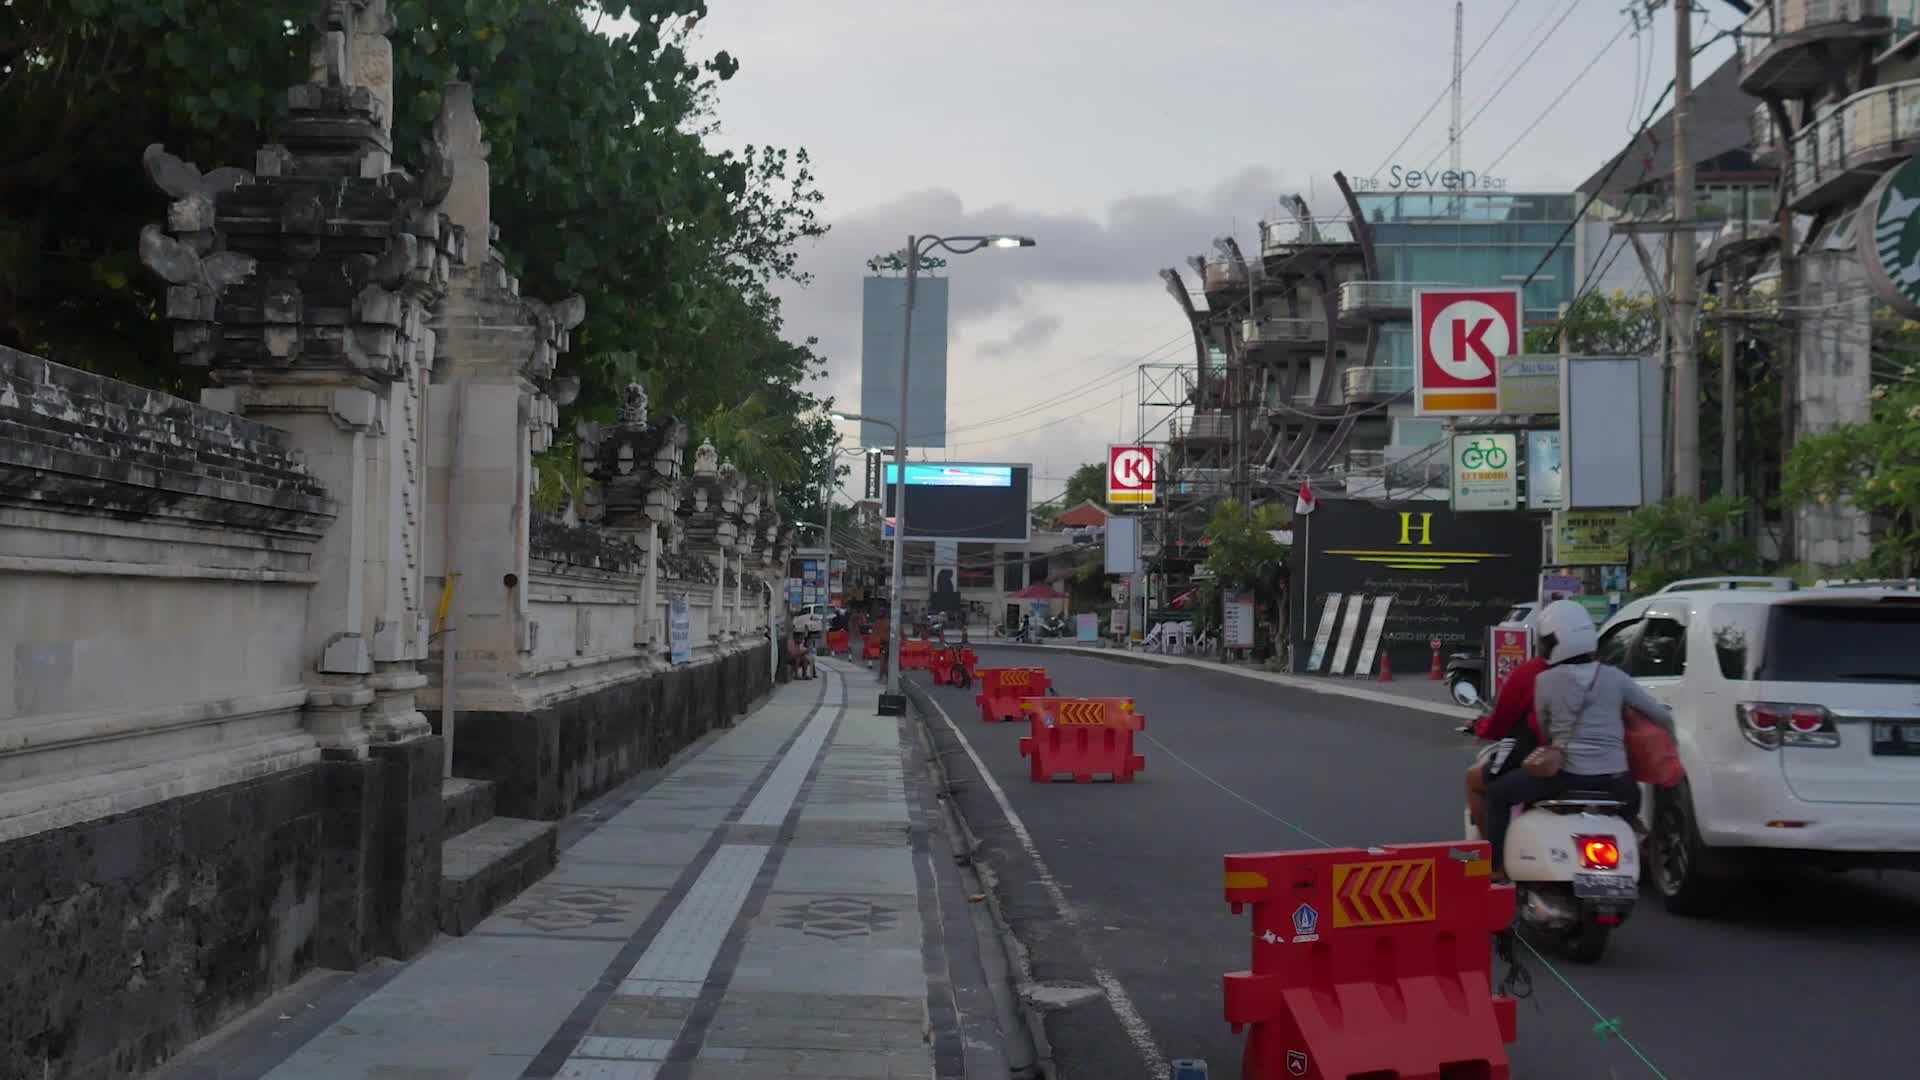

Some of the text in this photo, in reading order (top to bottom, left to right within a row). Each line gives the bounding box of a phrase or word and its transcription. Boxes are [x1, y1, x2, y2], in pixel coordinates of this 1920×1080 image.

[1353, 165, 1507, 190] The Seven Bar
[1452, 318, 1496, 375] K
[1124, 459, 1144, 481] K
[1397, 512, 1432, 544] H
